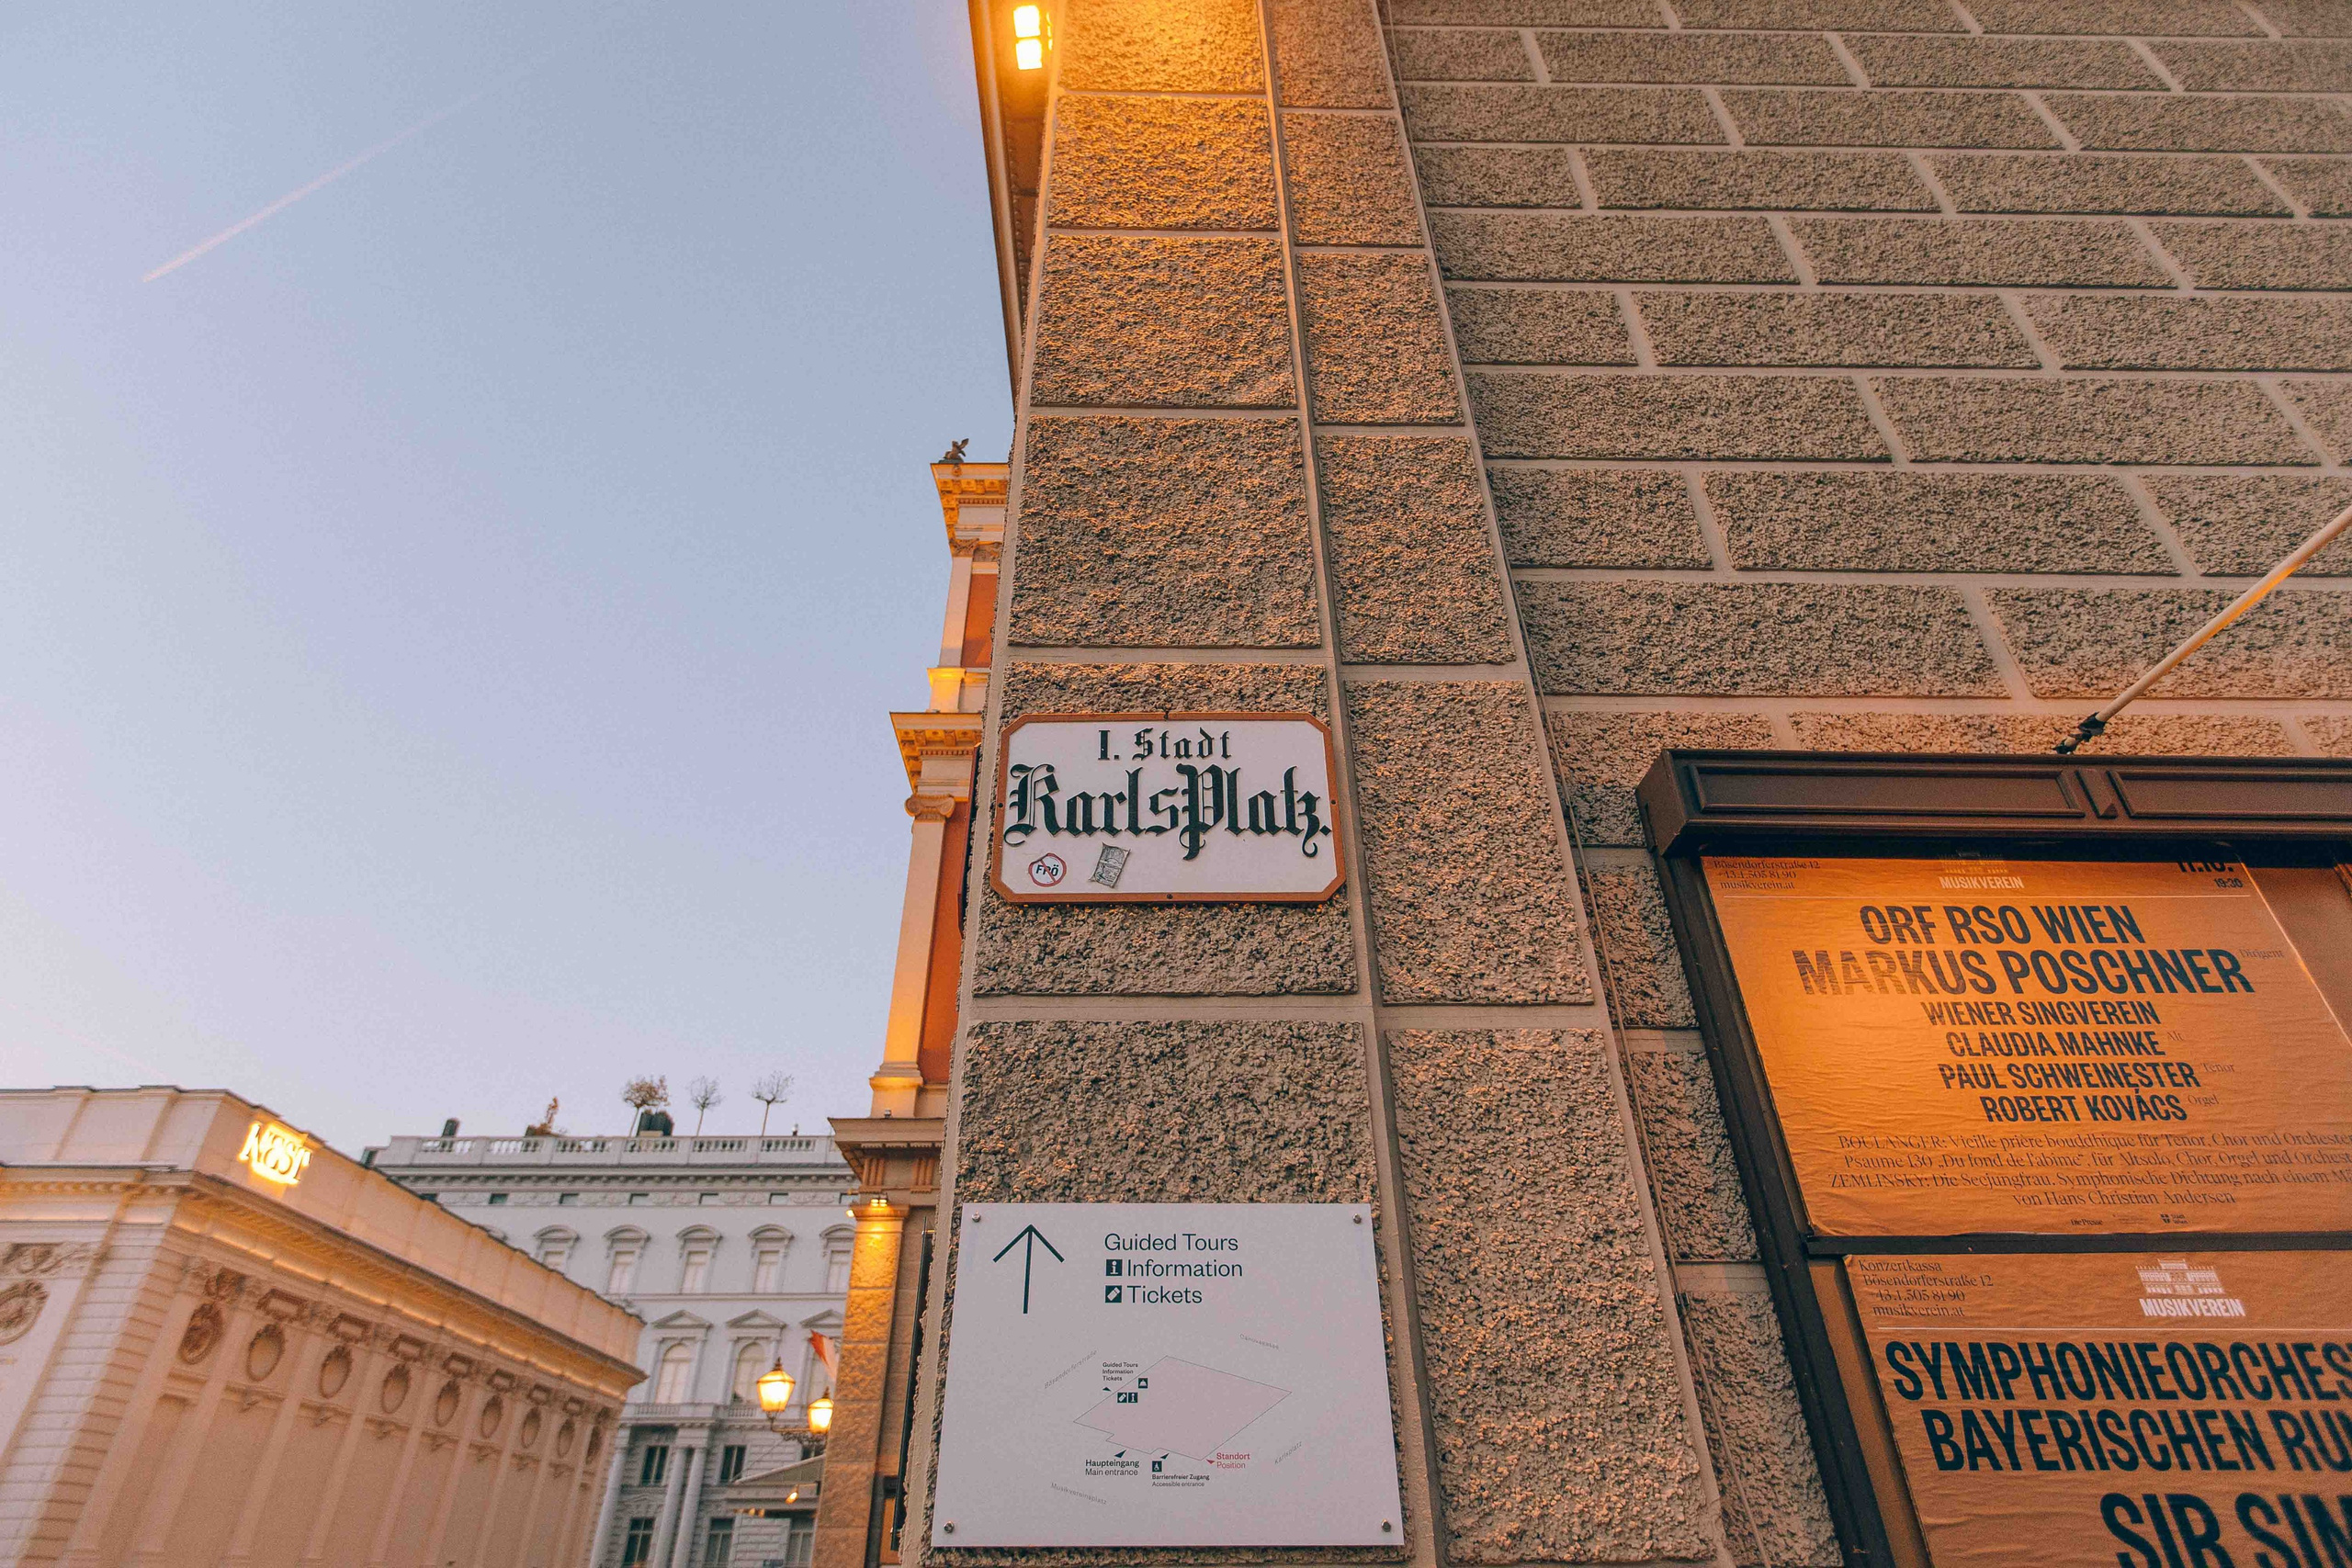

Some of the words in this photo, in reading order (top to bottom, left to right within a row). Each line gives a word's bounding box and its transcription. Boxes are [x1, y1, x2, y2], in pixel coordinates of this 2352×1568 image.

[1098, 729, 1120, 761] I.
[1132, 727, 1232, 761] Stadt
[1720, 879, 1796, 890] musikverein.at
[1781, 871, 1797, 879] 90
[1939, 876, 2025, 889] MUSIKVEREIN
[2213, 878, 2244, 888] 19:30
[1860, 905, 1936, 944] ORF
[1942, 905, 2031, 944] RSO
[2030, 905, 2146, 944] WIEN
[1791, 949, 1997, 995] MARKUS
[1996, 949, 2256, 995] POSCHNER
[2239, 948, 2285, 960] Dirigent
[1920, 1000, 2017, 1026] WIENER
[2016, 999, 2162, 1025] SINGVEREIN
[1945, 1031, 2057, 1056] CLAUDIA
[2054, 1031, 2165, 1056] MAHNKE
[1937, 1063, 2007, 1089] PAUL
[2007, 1061, 2201, 1089] SCHWEINESTER
[2200, 1062, 2235, 1073] Tenor
[1979, 1095, 2082, 1122] ROBERT
[2082, 1087, 2188, 1122] KOVÁCS
[2187, 1093, 2220, 1108] Orgel
[1838, 1135, 1948, 1149] BOULANGER:
[1949, 1134, 1996, 1149] Vieille
[1998, 1134, 2044, 1151] prière
[2044, 1132, 2135, 1150] bouddhique
[2137, 1133, 2160, 1147] für
[2211, 1131, 2250, 1147] Chor
[2250, 1132, 2282, 1146] und
[1844, 1155, 1905, 1168] Psaume
[1905, 1155, 1934, 1168] 130
[1967, 1153, 2007, 1168] fond
[2006, 1152, 2027, 1167] de
[2092, 1152, 2115, 1167] für
[2217, 1150, 2261, 1168] Orgel
[2262, 1149, 2294, 1165] und
[1828, 1173, 1930, 1188] ZEMLINSKY:
[1932, 1173, 1960, 1187] Die
[2055, 1171, 2167, 1190] Symphonische
[2170, 1170, 2244, 1188] Dichtung
[2243, 1169, 2278, 1184] nach
[2281, 1169, 2331, 1184] einem
[2012, 1194, 2043, 1205] von
[2044, 1192, 2086, 1205] Hans
[2086, 1190, 2160, 1205] Christian
[2162, 1190, 2236, 1204] Andersen
[1104, 1233, 1177, 1251] Guided
[1182, 1233, 1238, 1251] Tours
[1127, 1258, 1243, 1278] Information
[1858, 1258, 1942, 1271] Konzertkassa
[1862, 1274, 1977, 1287] Bösendorferstraße
[1979, 1274, 1994, 1286] 12
[1126, 1285, 1203, 1304] Tickets
[1932, 1289, 1947, 1301] 81
[1947, 1289, 1965, 1302] 90
[1872, 1303, 1965, 1316] musikverein.at
[2138, 1298, 2245, 1316] MUSIKVEREIN
[1885, 1341, 2352, 1400] SYMPHONIEORCHES
[1920, 1409, 2275, 1471] BAYERISCHEN
[1085, 1459, 1140, 1468] Haupteingang
[1216, 1452, 1250, 1461] Standort
[1104, 1468, 1138, 1476] entrance
[2100, 1493, 2235, 1568] SIR
